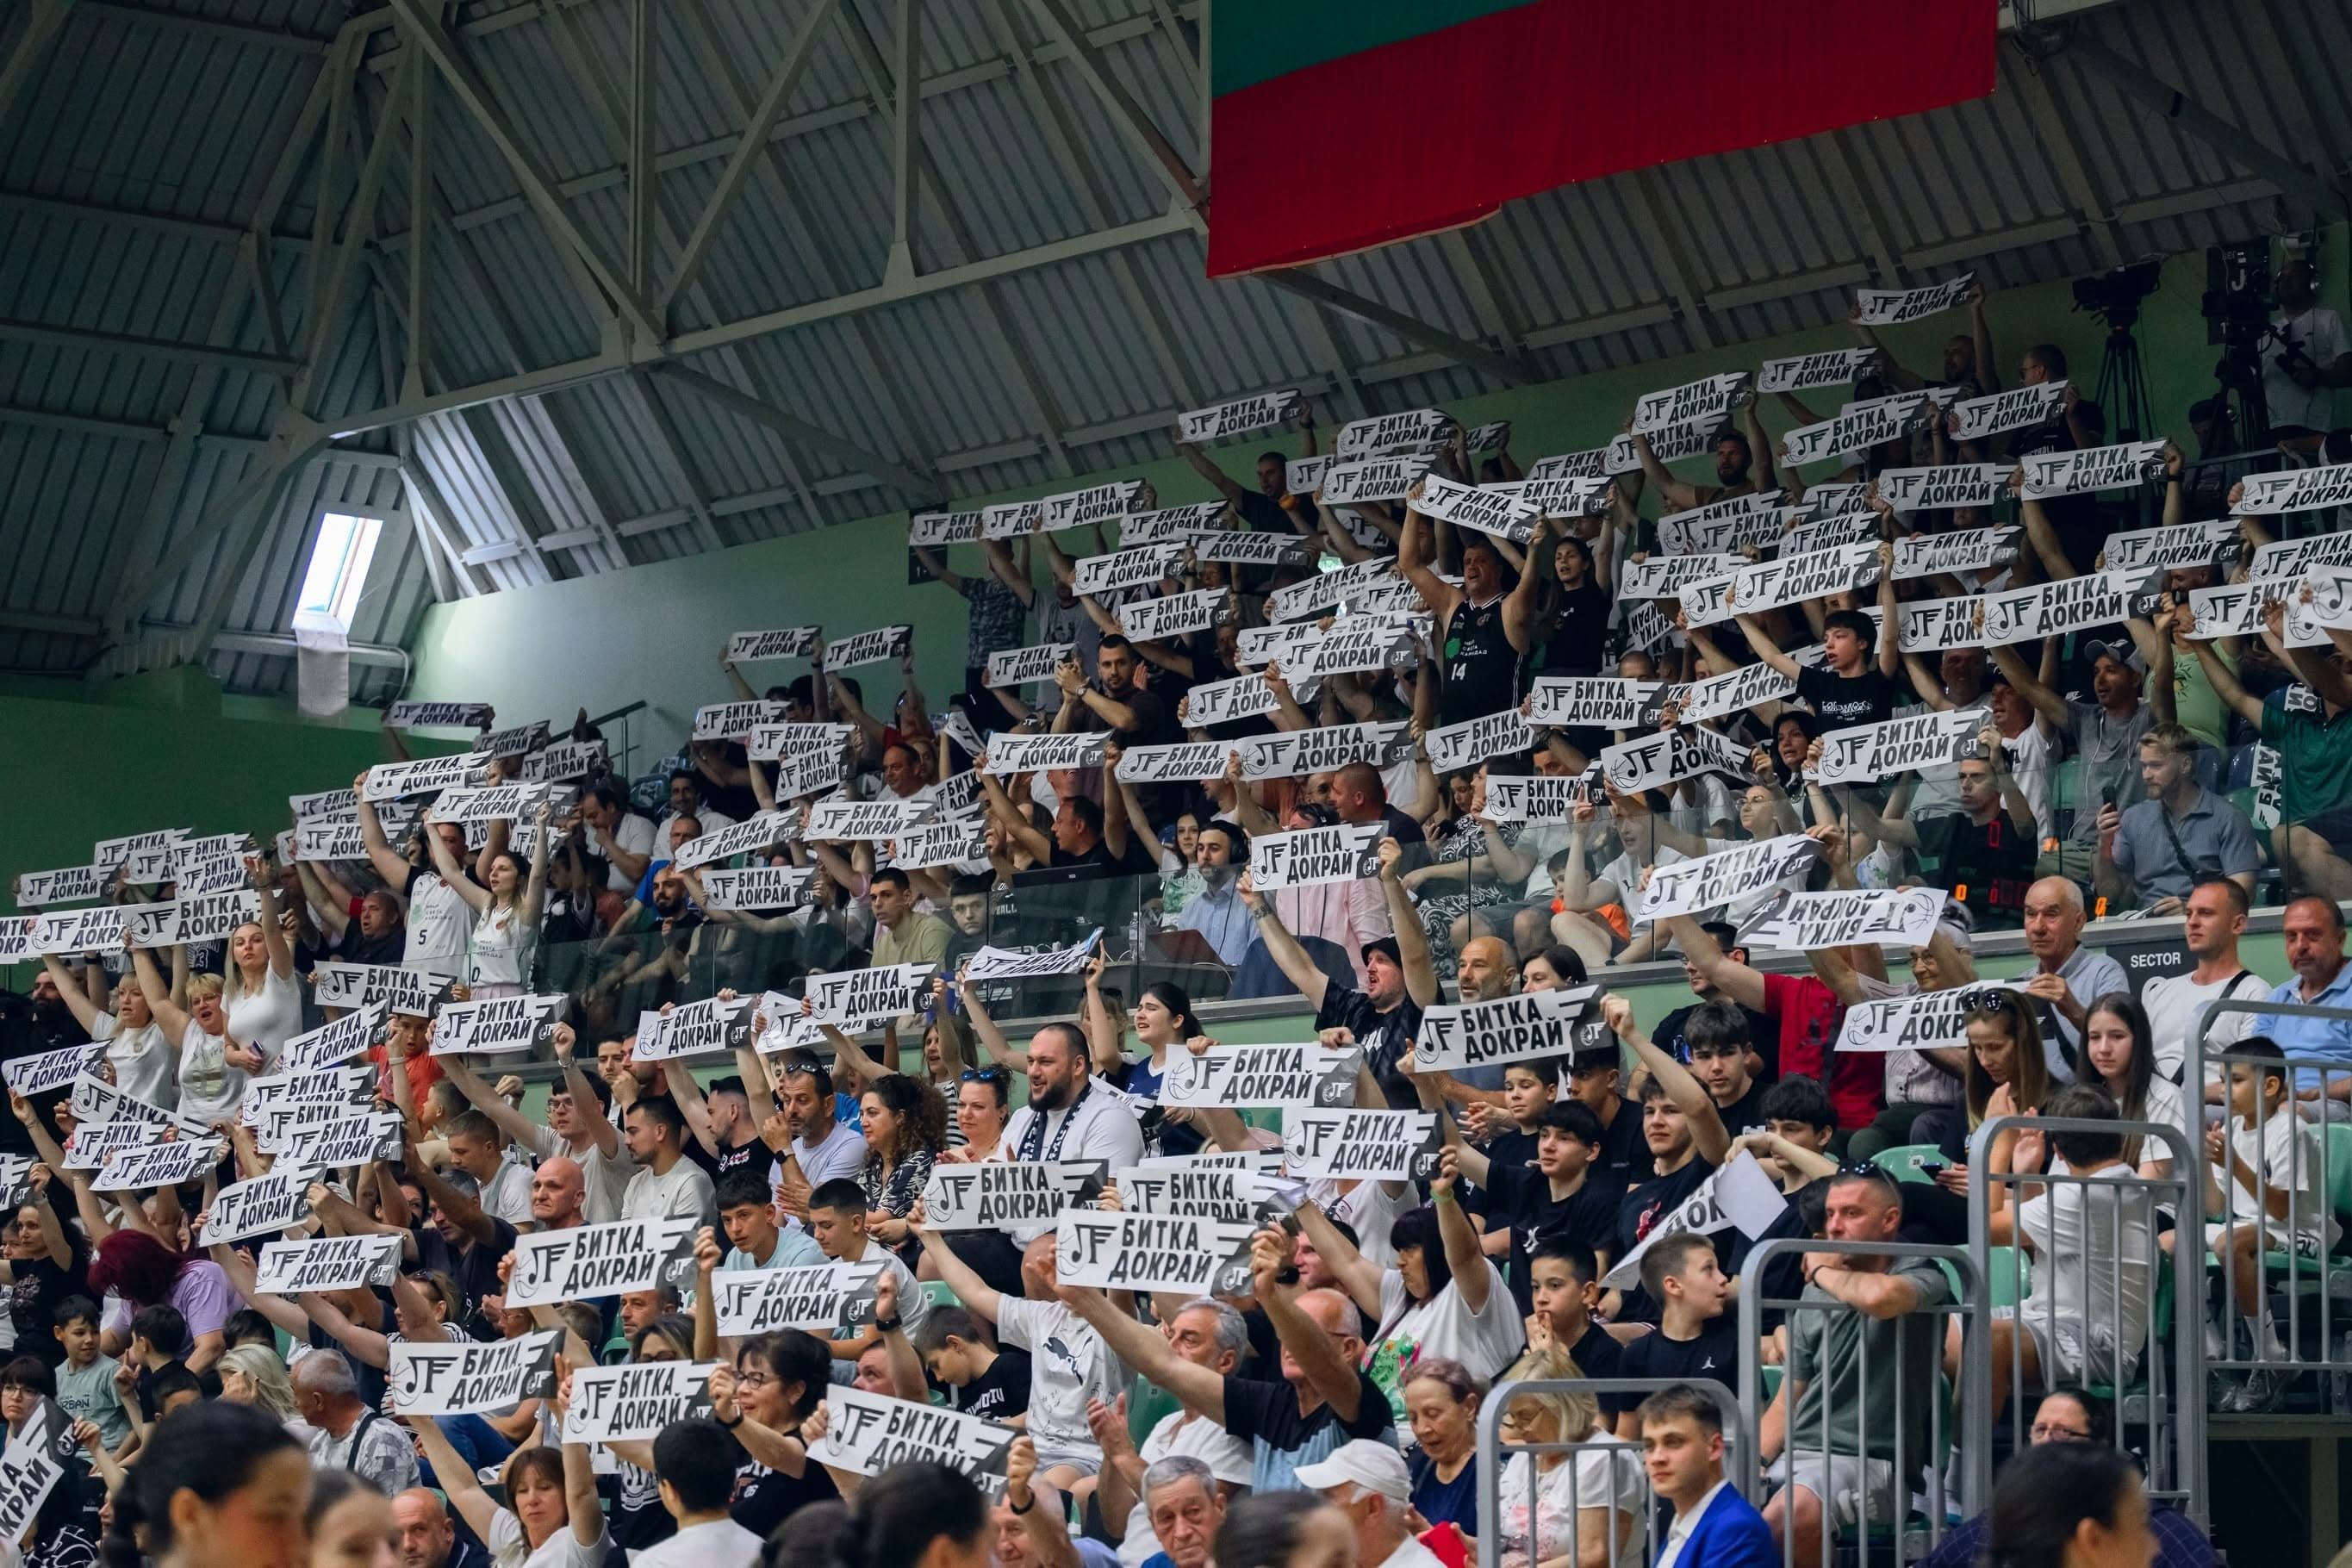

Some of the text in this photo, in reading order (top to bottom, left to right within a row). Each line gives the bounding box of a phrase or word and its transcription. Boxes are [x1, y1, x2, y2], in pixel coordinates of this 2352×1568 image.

[1892, 293, 1951, 320] ДОКРАЙ
[1904, 284, 1948, 305] БИТКА
[1801, 352, 1847, 370] БИТКА
[1792, 364, 1851, 387] ДОКРАЙ
[1675, 380, 1716, 405] БИТКА
[1996, 389, 2039, 413] БИТКА
[1220, 397, 1266, 419] БИТКА
[1668, 391, 1723, 424] ДОКРАЙ
[1988, 400, 2045, 432] ДОКРАЙ
[1216, 408, 1275, 436] ДОКРАЙ
[1378, 413, 1422, 431] БИТКА
[1647, 422, 1694, 445] БИТКА
[1833, 408, 1887, 436] БИТКА
[1371, 423, 1429, 449] ДОКРАЙ
[1826, 418, 1897, 456] ДОКРАЙ
[2073, 447, 2129, 471] БИТКА
[1360, 464, 1401, 482] БИТКА
[1926, 467, 1982, 485] БИТКА
[2066, 460, 2137, 492] ДОКРАЙ
[1077, 488, 1117, 507] БИТКА
[1353, 476, 1406, 500] ДОКРАЙ
[1523, 480, 1574, 499] БИТКА
[1918, 482, 1990, 507] ДОКРАЙ
[1073, 497, 1123, 524] ДОКРАЙ
[1157, 505, 1198, 522] БИТКА
[1462, 490, 1511, 513] БИТКА
[1447, 503, 1511, 531] ДОКРАЙ
[1733, 510, 1782, 533] БИТКА
[1814, 517, 1851, 538] БИТКА
[1218, 532, 1271, 544] БИТКА
[1933, 531, 1985, 550] БИТКА
[2154, 525, 2206, 546] БИТКА
[2298, 533, 2351, 559] БИТКА
[1112, 548, 1155, 568] БИТКА
[1207, 543, 1278, 558] ДОКРАЙ
[1925, 544, 1991, 572] ДОКРАЙ
[2144, 540, 2212, 564] ДОКРАЙ
[1105, 558, 1161, 587] ДОКРАЙ
[1667, 557, 1715, 576] БИТКА
[1784, 550, 1841, 579] БИТКА
[1313, 565, 1360, 589] БИТКА
[1775, 563, 1851, 603] ДОКРАЙ
[2042, 575, 2108, 606] БИТКА
[1157, 594, 1198, 616] БИТКА
[2037, 591, 2123, 634] ДОКРАЙ
[1153, 603, 1206, 635] ДОКРАЙ
[750, 641, 797, 657] ДОКРАЙ
[758, 631, 794, 644] БИТКА
[850, 632, 883, 649] БИТКА
[1321, 632, 1373, 650] БИТКА
[844, 642, 887, 666] ДОКРАЙ
[1018, 647, 1051, 663] БИТКА
[1313, 644, 1380, 672] ДОКРАЙ
[1013, 658, 1055, 681] ДОКРАЙ
[1451, 663, 1466, 681] 14
[1575, 681, 1626, 700] БИТКА
[413, 712, 464, 725] ДОКРАЙ
[420, 703, 460, 713] БИТКА
[725, 703, 762, 718] БИТКА
[1567, 699, 1635, 722] ДОКРАЙ
[785, 725, 826, 740] БИТКА
[1472, 712, 1520, 740] БИТКА
[1876, 717, 1938, 746] БИТКА
[1027, 736, 1075, 749] БИТКА
[1299, 727, 1364, 750] БИТКА
[1467, 725, 1530, 762] ДОКРАЙ
[544, 747, 576, 766] БИТКА
[799, 752, 831, 772] БИТКА
[1018, 747, 1080, 768] ДОКРАЙ
[1167, 744, 1220, 762] БИТКА
[1292, 740, 1376, 773] ДОКРАЙ
[1868, 733, 1947, 774] ДОКРАЙ
[409, 757, 459, 774] БИТКА
[543, 756, 585, 780] ДОКРАЙ
[800, 760, 837, 793] ДОКРАЙ
[1154, 758, 1223, 779] ДОКРАЙ
[475, 785, 519, 801] БИТКА
[460, 798, 518, 816] ДОКРАЙ
[851, 804, 898, 819] БИТКА
[128, 834, 165, 850] БИТКА
[720, 820, 768, 841] БИТКА
[925, 824, 962, 846] БИТКА
[196, 839, 227, 854] БИТКА
[711, 829, 770, 860] ДОКРАЙ
[919, 837, 969, 866] ДОКРАЙ
[1291, 831, 1342, 856] БИТКА
[205, 856, 236, 876] БИТКА
[1287, 848, 1353, 884] ДОКРАЙ
[1702, 844, 1772, 880] БИТКА
[53, 870, 91, 884] БИТКА
[200, 864, 245, 893] ДОКРАЙ
[738, 868, 781, 887] БИТКА
[1688, 856, 1776, 910] ДОКРАЙ
[49, 879, 97, 900] ДОКРАЙ
[736, 885, 791, 906] ДОКРАЙ
[181, 898, 242, 918] БИТКА
[176, 910, 253, 939] ДОКРАЙ
[418, 930, 428, 945] 5
[2131, 952, 2181, 968] SECTOR
[367, 968, 419, 990] БИТКА
[850, 968, 899, 992] БИТКА
[361, 987, 426, 1011] ДОКРАЙ
[476, 999, 526, 1021] БИТКА
[845, 986, 909, 1018] ДОКРАЙ
[674, 1004, 713, 1028] БИТКА
[1461, 999, 1542, 1033] БИТКА
[320, 1013, 361, 1044] БИТКА
[467, 1017, 532, 1048] ДОКРАЙ
[669, 1020, 722, 1054] ДОКРАЙ
[1465, 1017, 1563, 1063] ДОКРАЙ
[312, 1026, 367, 1067] ДОКРАЙ
[38, 1049, 81, 1070] БИТКА
[1233, 1048, 1304, 1073] БИТКА
[28, 1058, 83, 1092] ДОКРАЙ
[287, 1071, 338, 1095] БИТКА
[1219, 1069, 1314, 1103] ДОКРАЙ
[116, 1094, 168, 1123] БИТКА
[103, 1125, 140, 1144] БИТКА
[320, 1118, 368, 1142] БИТКА
[1342, 1115, 1406, 1142] БИТКА
[146, 1143, 189, 1164] БИТКА
[309, 1136, 374, 1162] ДОКРАЙ
[1328, 1139, 1412, 1173] ДОКРАЙ
[131, 1157, 190, 1186] ДОКРАЙ
[980, 1166, 1049, 1192] БИТКА
[244, 1174, 287, 1198] БИТКА
[1170, 1173, 1234, 1199] БИТКА
[237, 1191, 293, 1234] ДОКРАЙ
[978, 1187, 1065, 1223] ДОКРАЙ
[575, 1224, 644, 1260] БИТКА
[1122, 1219, 1198, 1251] БИТКА
[304, 1240, 362, 1262] БИТКА
[287, 1258, 366, 1289] ДОКРАЙ
[562, 1248, 656, 1295] ДОКРАЙ
[1109, 1250, 1214, 1285] ДОКРАЙ
[764, 1268, 835, 1297] БИТКА
[751, 1289, 838, 1328] ДОКРАЙ
[462, 1342, 520, 1375] БИТКА
[446, 1364, 520, 1409] ДОКРАЙ
[619, 1367, 671, 1399] БИТКА
[608, 1390, 680, 1435] ДОКРАЙ
[885, 1406, 961, 1448] БИТКА
